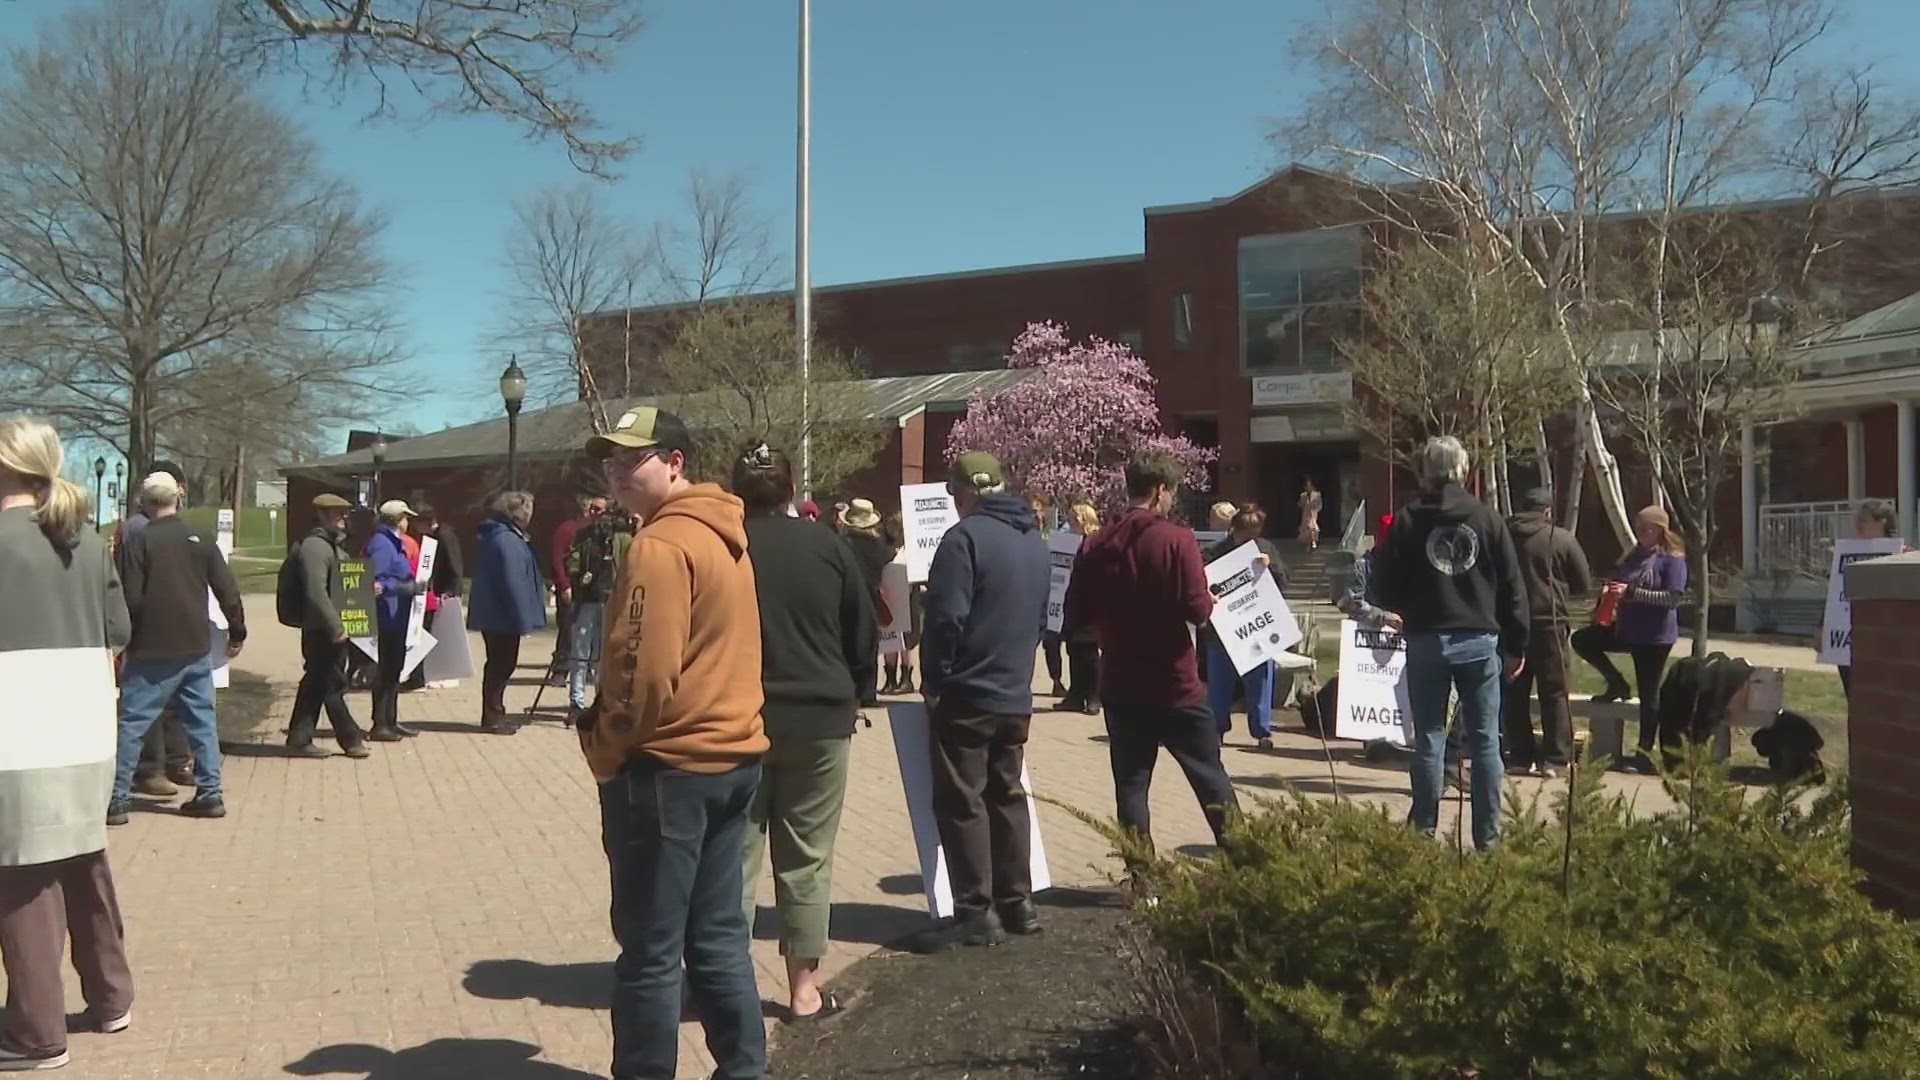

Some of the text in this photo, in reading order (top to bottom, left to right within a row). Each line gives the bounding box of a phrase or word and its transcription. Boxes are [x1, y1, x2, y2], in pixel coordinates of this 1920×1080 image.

[917, 537, 944, 549] WAG
[340, 562, 365, 573] EQUAL
[343, 575, 360, 591] PAY
[341, 608, 368, 620] EQUAL
[1049, 602, 1062, 618] GE
[1235, 611, 1275, 641] WAGE
[1830, 630, 1852, 648] WA
[1357, 663, 1401, 677] DESERVE
[1350, 704, 1404, 726] WAGE
